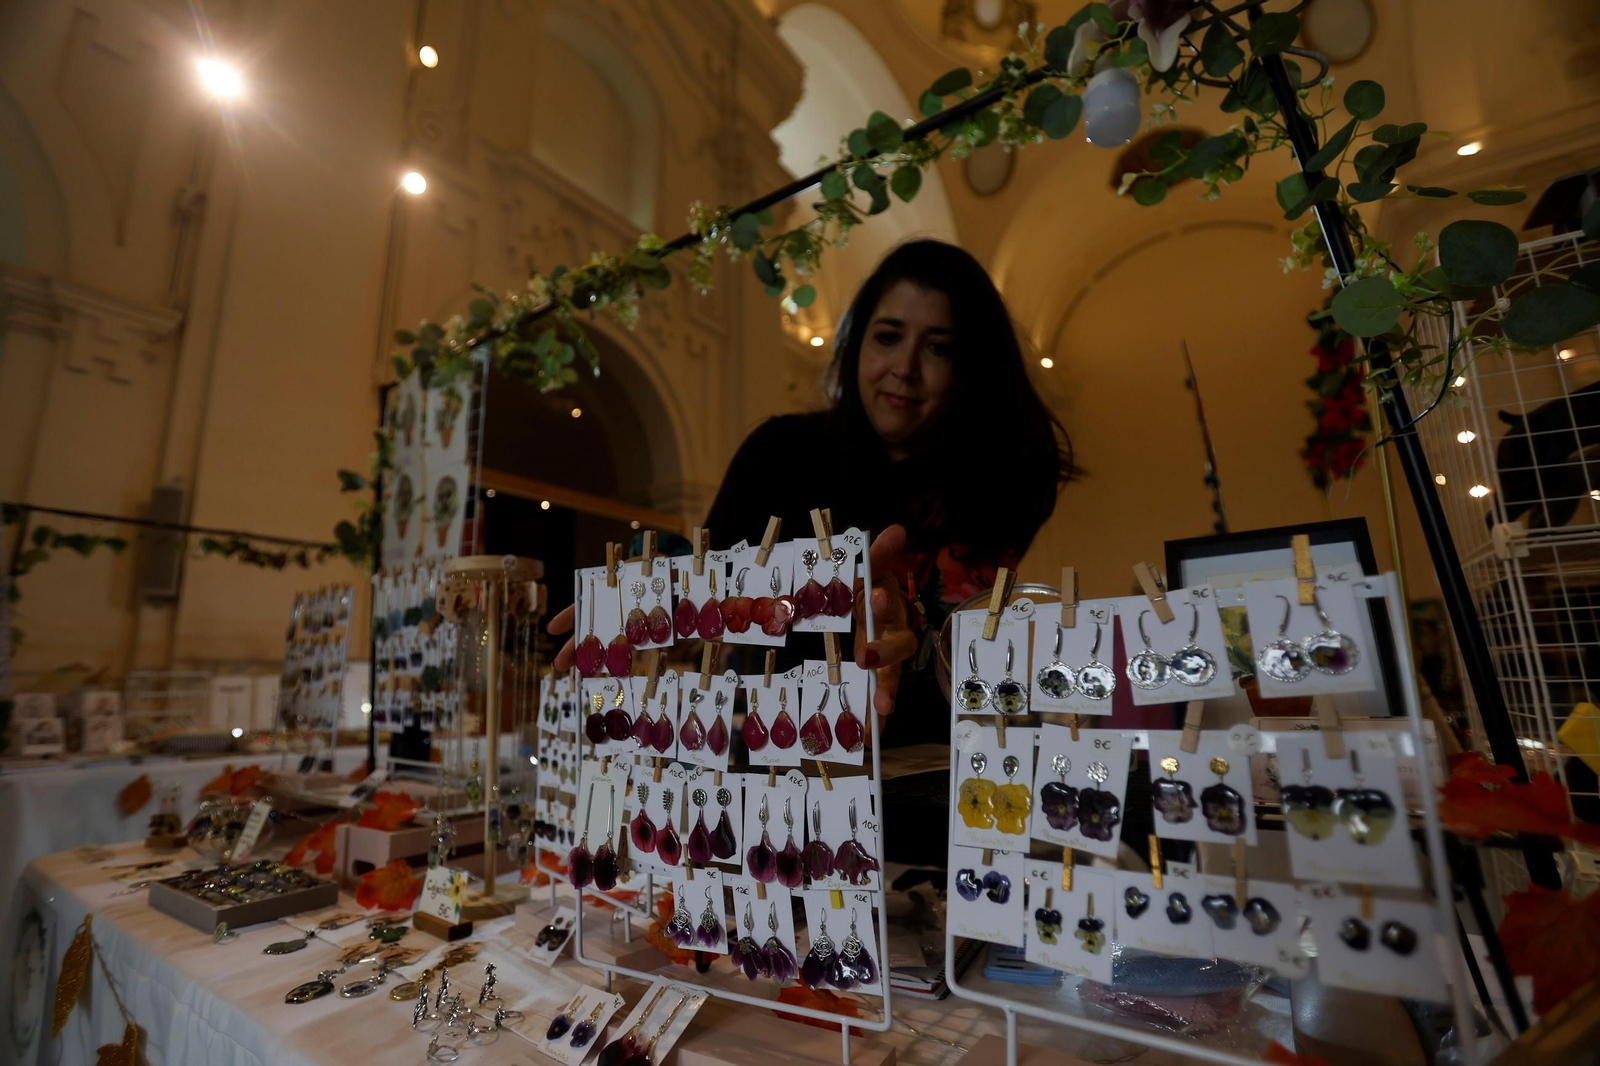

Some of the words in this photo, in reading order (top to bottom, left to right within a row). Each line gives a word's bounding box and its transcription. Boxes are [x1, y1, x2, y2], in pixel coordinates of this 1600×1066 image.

[843, 534, 862, 546] 12€
[734, 543, 746, 554] 12€
[1326, 571, 1350, 582] 9€
[1192, 589, 1209, 598] 9€
[1012, 602, 1031, 612] 9€
[1089, 609, 1105, 619] 9€
[808, 620, 827, 631] Rosa
[783, 671, 797, 680] 9€
[806, 665, 825, 677] 10€
[665, 673, 677, 684] 10€
[725, 675, 738, 684] 10€
[602, 684, 616, 692] 12€
[1094, 739, 1112, 750] 8€
[613, 762, 628, 772] 14€
[591, 774, 612, 784] Geranio
[669, 768, 684, 779] 12€
[689, 768, 702, 782] 10€
[789, 776, 804, 787] 12€
[861, 820, 879, 833] 10€
[706, 871, 717, 879] 9€
[1173, 867, 1191, 879] 5€
[735, 886, 749, 896] 12€
[854, 893, 868, 903] 12€
[437, 903, 452, 919] 5€
